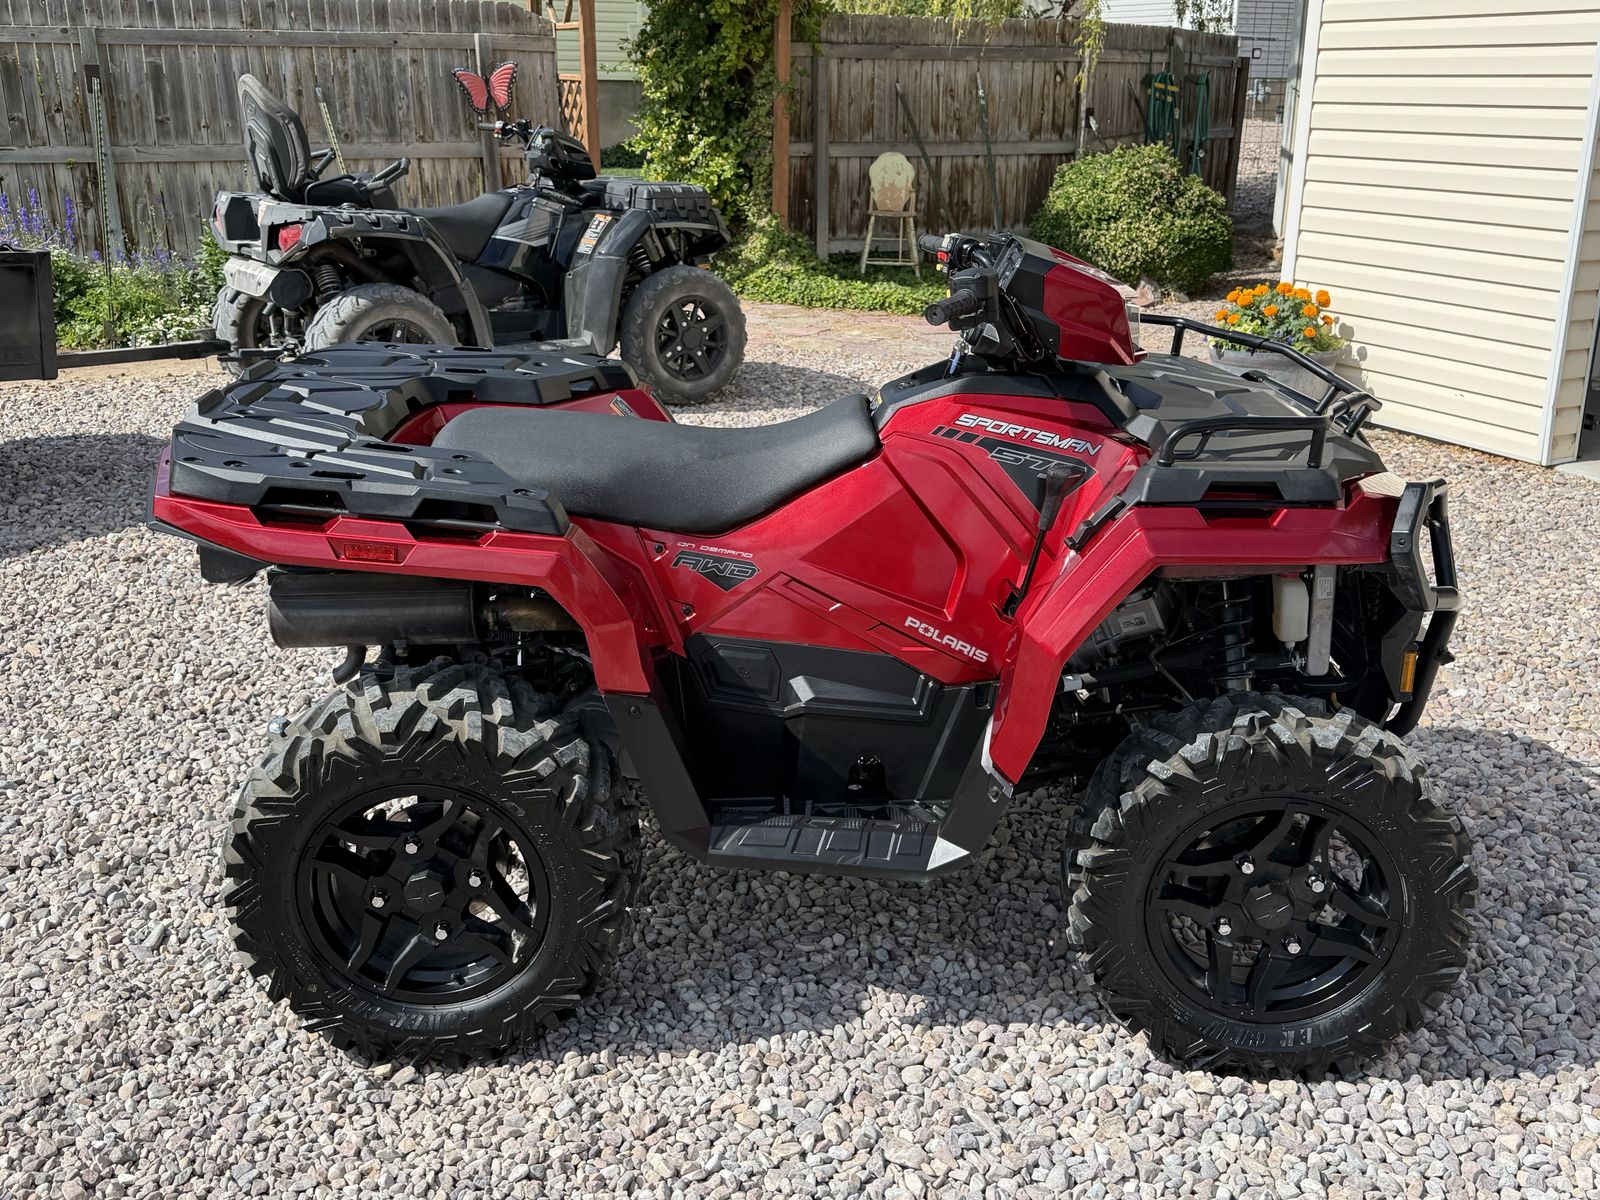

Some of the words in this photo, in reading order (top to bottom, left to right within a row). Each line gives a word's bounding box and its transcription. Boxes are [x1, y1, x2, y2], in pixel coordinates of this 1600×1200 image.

[954, 413, 1103, 456] SPORTSMAN
[671, 554, 759, 580] AWD
[700, 545, 753, 558] DEMAND
[904, 616, 989, 663] POLARIS
